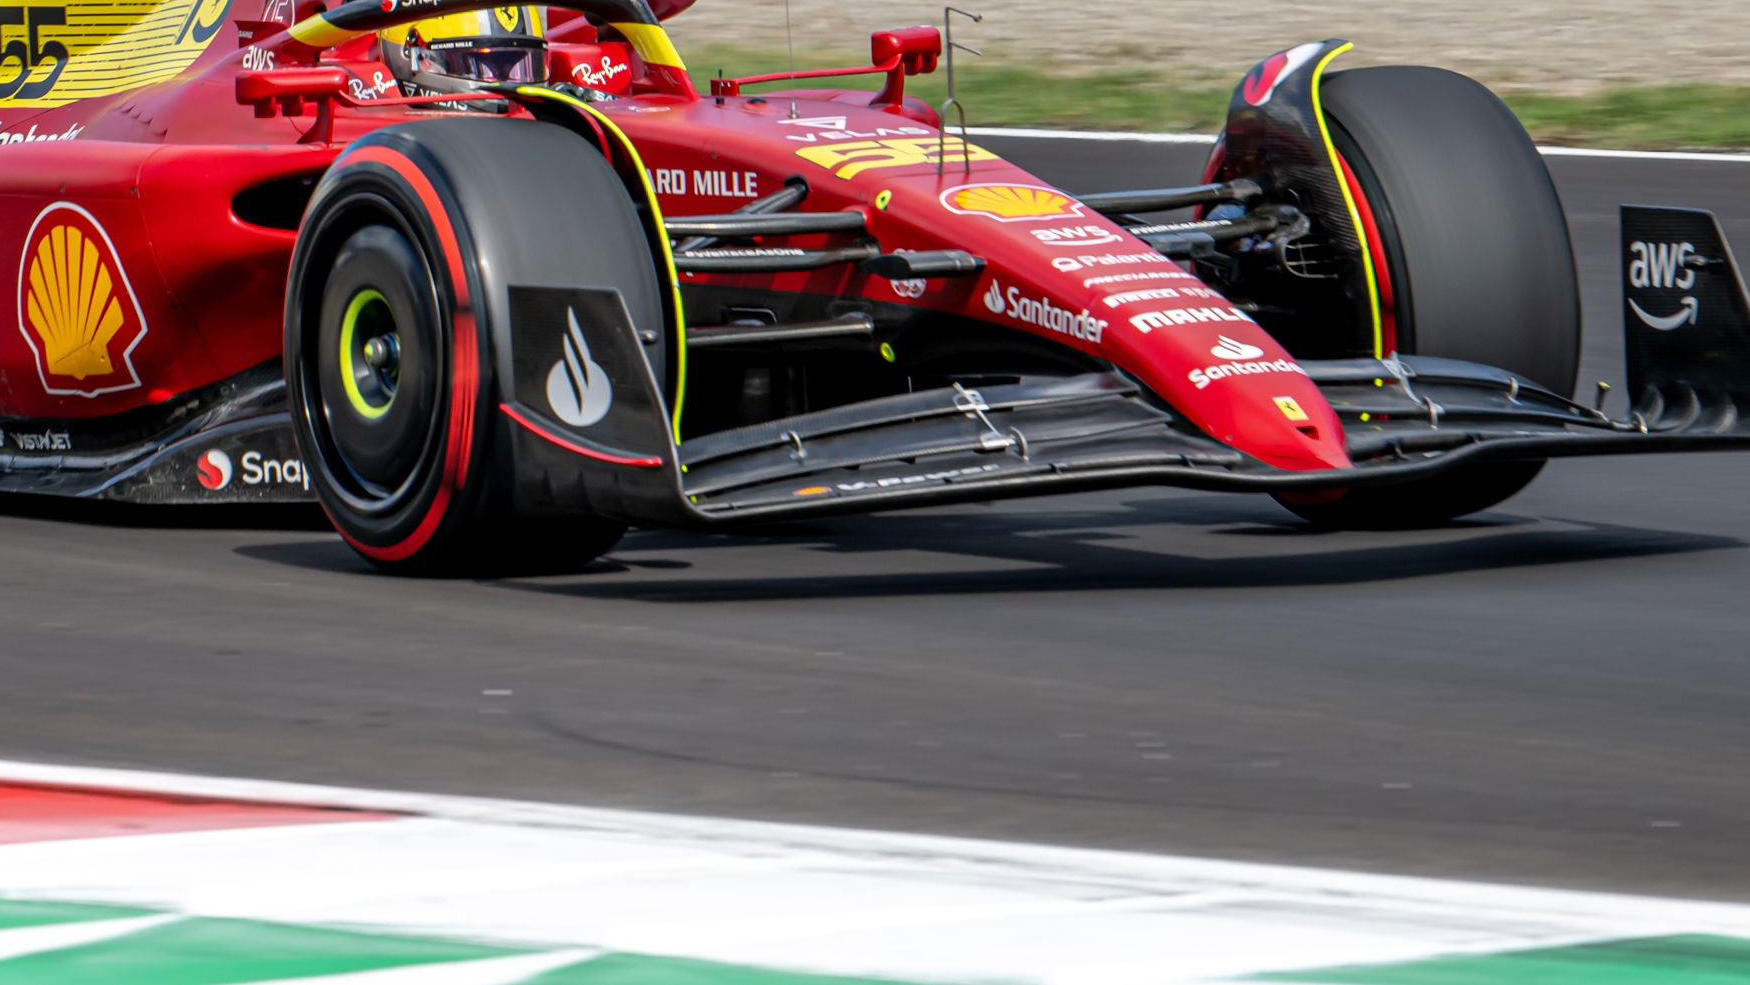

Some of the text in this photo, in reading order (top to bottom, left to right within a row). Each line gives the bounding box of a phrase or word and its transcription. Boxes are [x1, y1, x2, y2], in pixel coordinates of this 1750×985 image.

[243, 45, 275, 71] aws
[431, 42, 454, 50] RICHARD
[572, 56, 628, 85] Ray-Ban
[786, 126, 931, 142] VELAS
[794, 137, 1000, 180] 55
[693, 169, 759, 198] MILLE
[1030, 225, 1110, 242] aws
[1084, 271, 1200, 288] FRECCIAROSS
[1629, 241, 1697, 291] aws
[1006, 285, 1109, 344] Santander
